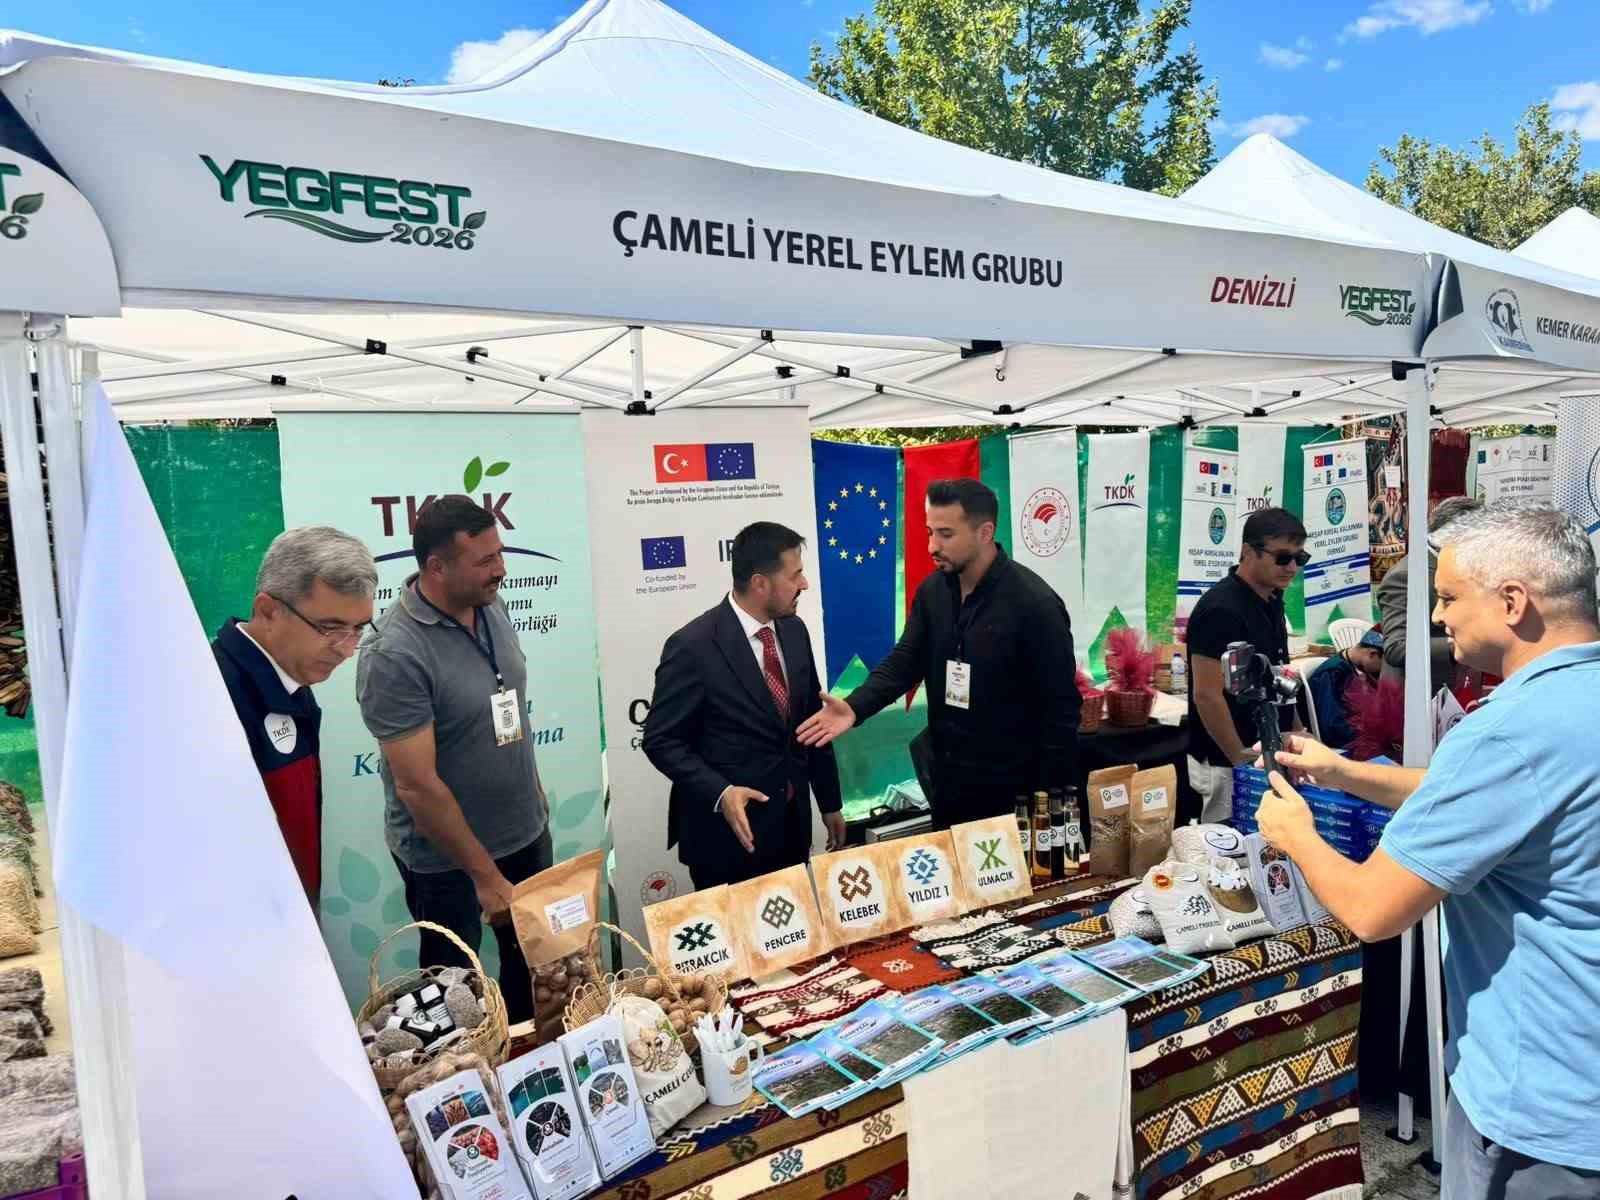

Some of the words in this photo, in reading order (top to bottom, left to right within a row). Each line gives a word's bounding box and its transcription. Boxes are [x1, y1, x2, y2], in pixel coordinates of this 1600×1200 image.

[199, 154, 471, 228] YEGFEST
[391, 222, 475, 250] 2026
[612, 210, 755, 259] ÇAMELİ
[763, 228, 863, 270] YEREL
[870, 241, 965, 279] EYLEM
[972, 252, 1063, 287] GRUBU
[1210, 274, 1296, 308] DENİZLİ
[1339, 284, 1412, 313] YEGFEST
[1386, 313, 1412, 326] 2026
[1536, 316, 1570, 339] KEMER
[1104, 485, 1136, 500] TKDK
[371, 492, 515, 536] TKK
[498, 573, 558, 594] kınmayı
[978, 871, 1014, 887] ULMACIK
[908, 888, 943, 904] YILDIZ
[944, 886, 950, 898] 1
[839, 903, 881, 923] KELEBEK
[764, 929, 807, 951] PENCERE
